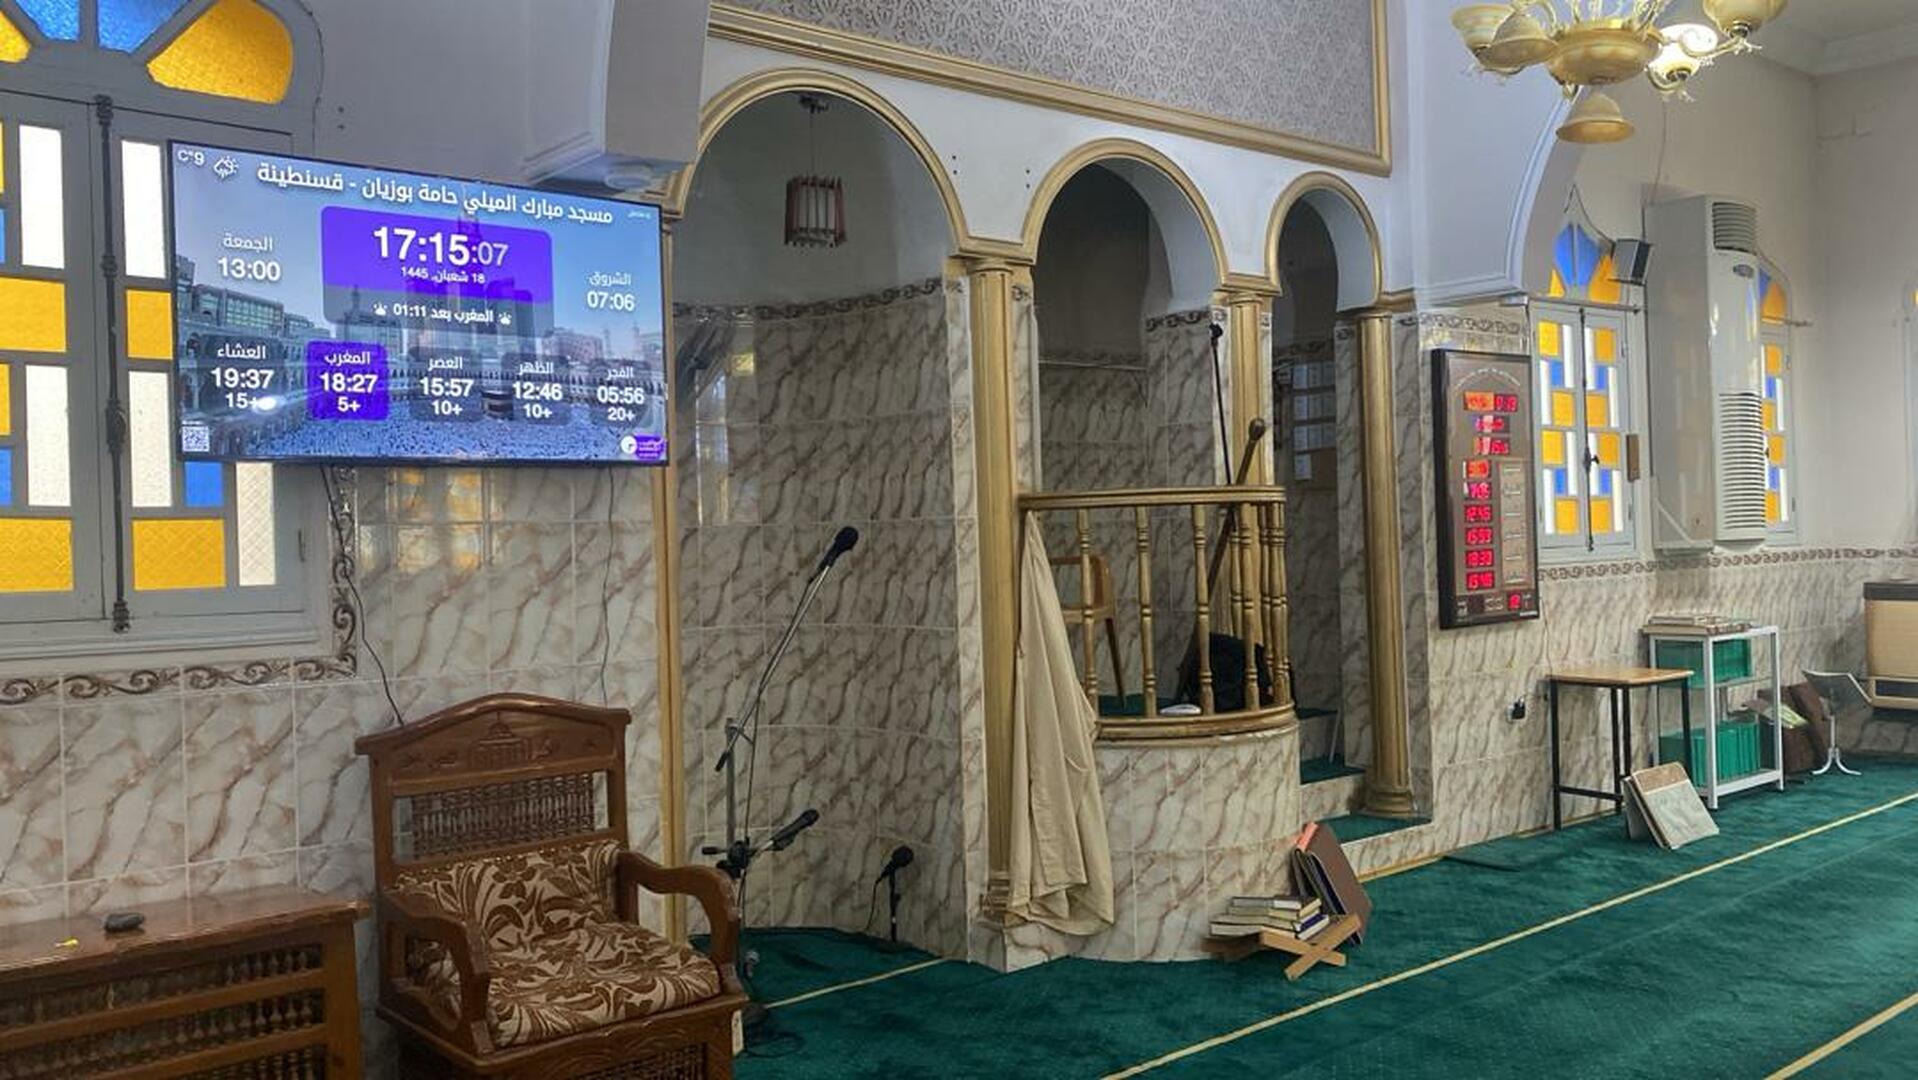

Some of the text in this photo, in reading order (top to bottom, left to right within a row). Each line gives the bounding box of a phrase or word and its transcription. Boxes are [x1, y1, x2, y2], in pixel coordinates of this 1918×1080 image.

[256, 162, 344, 191] قسنطينة
[361, 177, 413, 203] بوزيان
[418, 182, 458, 205] حامة
[463, 190, 517, 214] الميلي
[521, 197, 564, 219] مبارك
[567, 205, 613, 224] مسجد
[223, 230, 273, 253] الجمعة
[373, 226, 509, 267] 17:15:07
[217, 256, 282, 282] 13:00
[400, 266, 429, 280] 1445
[472, 272, 486, 284] 18
[589, 270, 632, 287] الشروق
[586, 291, 636, 312] 07:06
[393, 303, 494, 324] المغرب بعد 01:11
[217, 343, 266, 360] العشاء
[324, 351, 371, 366] المغرب
[428, 356, 463, 371] العصر
[518, 361, 554, 376] الظهر
[606, 366, 634, 380] الفجر
[210, 366, 275, 389] 19:37
[320, 372, 379, 394] 18:27
[420, 377, 474, 398] 15:57
[512, 381, 563, 401] 12:46
[596, 386, 645, 406] 05:56
[336, 397, 362, 413] 5+
[431, 400, 463, 417] 10+
[523, 404, 552, 419] 10+
[607, 406, 636, 422] 20+
